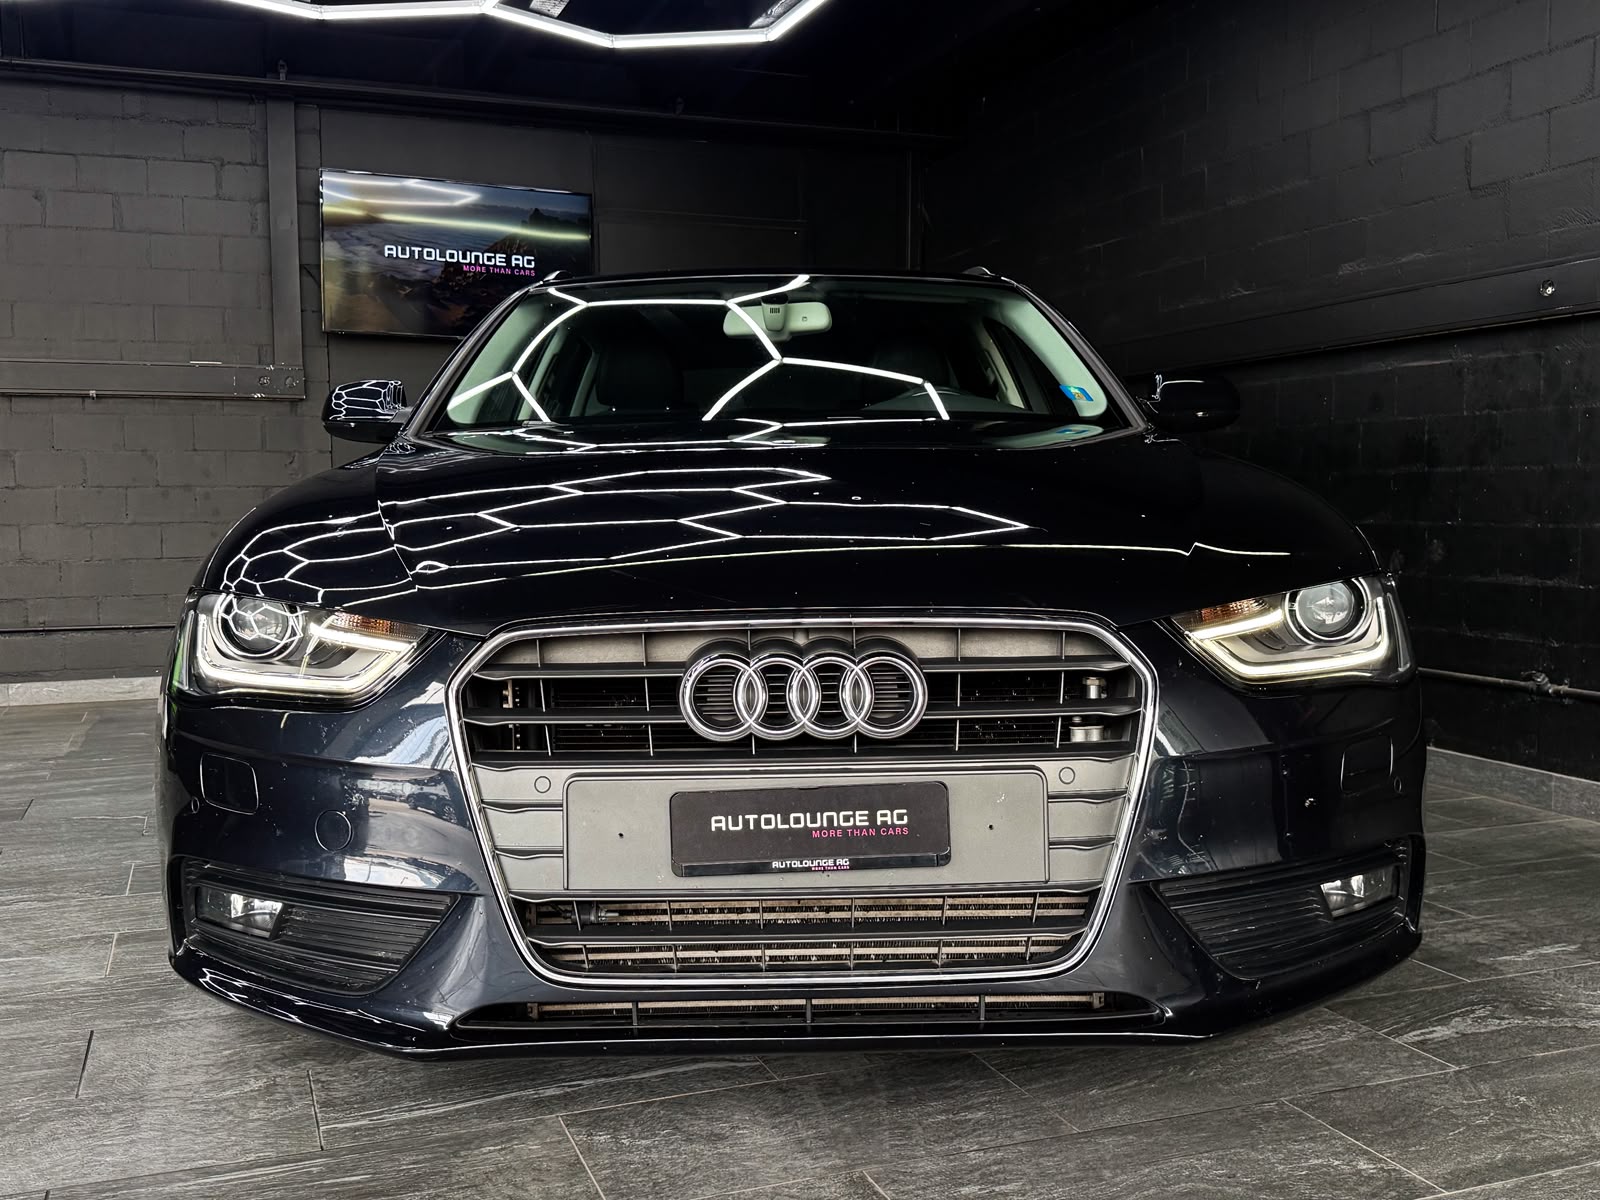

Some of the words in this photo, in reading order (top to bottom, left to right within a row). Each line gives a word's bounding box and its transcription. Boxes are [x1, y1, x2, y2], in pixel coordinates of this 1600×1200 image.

[384, 245, 507, 266] AUTOLOUNGE
[511, 255, 535, 268] AG
[463, 265, 487, 273] MORE
[489, 267, 511, 275] THAN
[514, 269, 536, 277] CARS
[711, 810, 869, 831] AUTOLOUNGE
[876, 809, 908, 825] AG
[812, 829, 843, 838] MORE
[847, 828, 876, 837] THAN
[880, 827, 909, 836] CARS
[772, 859, 834, 868] AUTOLOUNGE
[836, 858, 850, 866] AG
